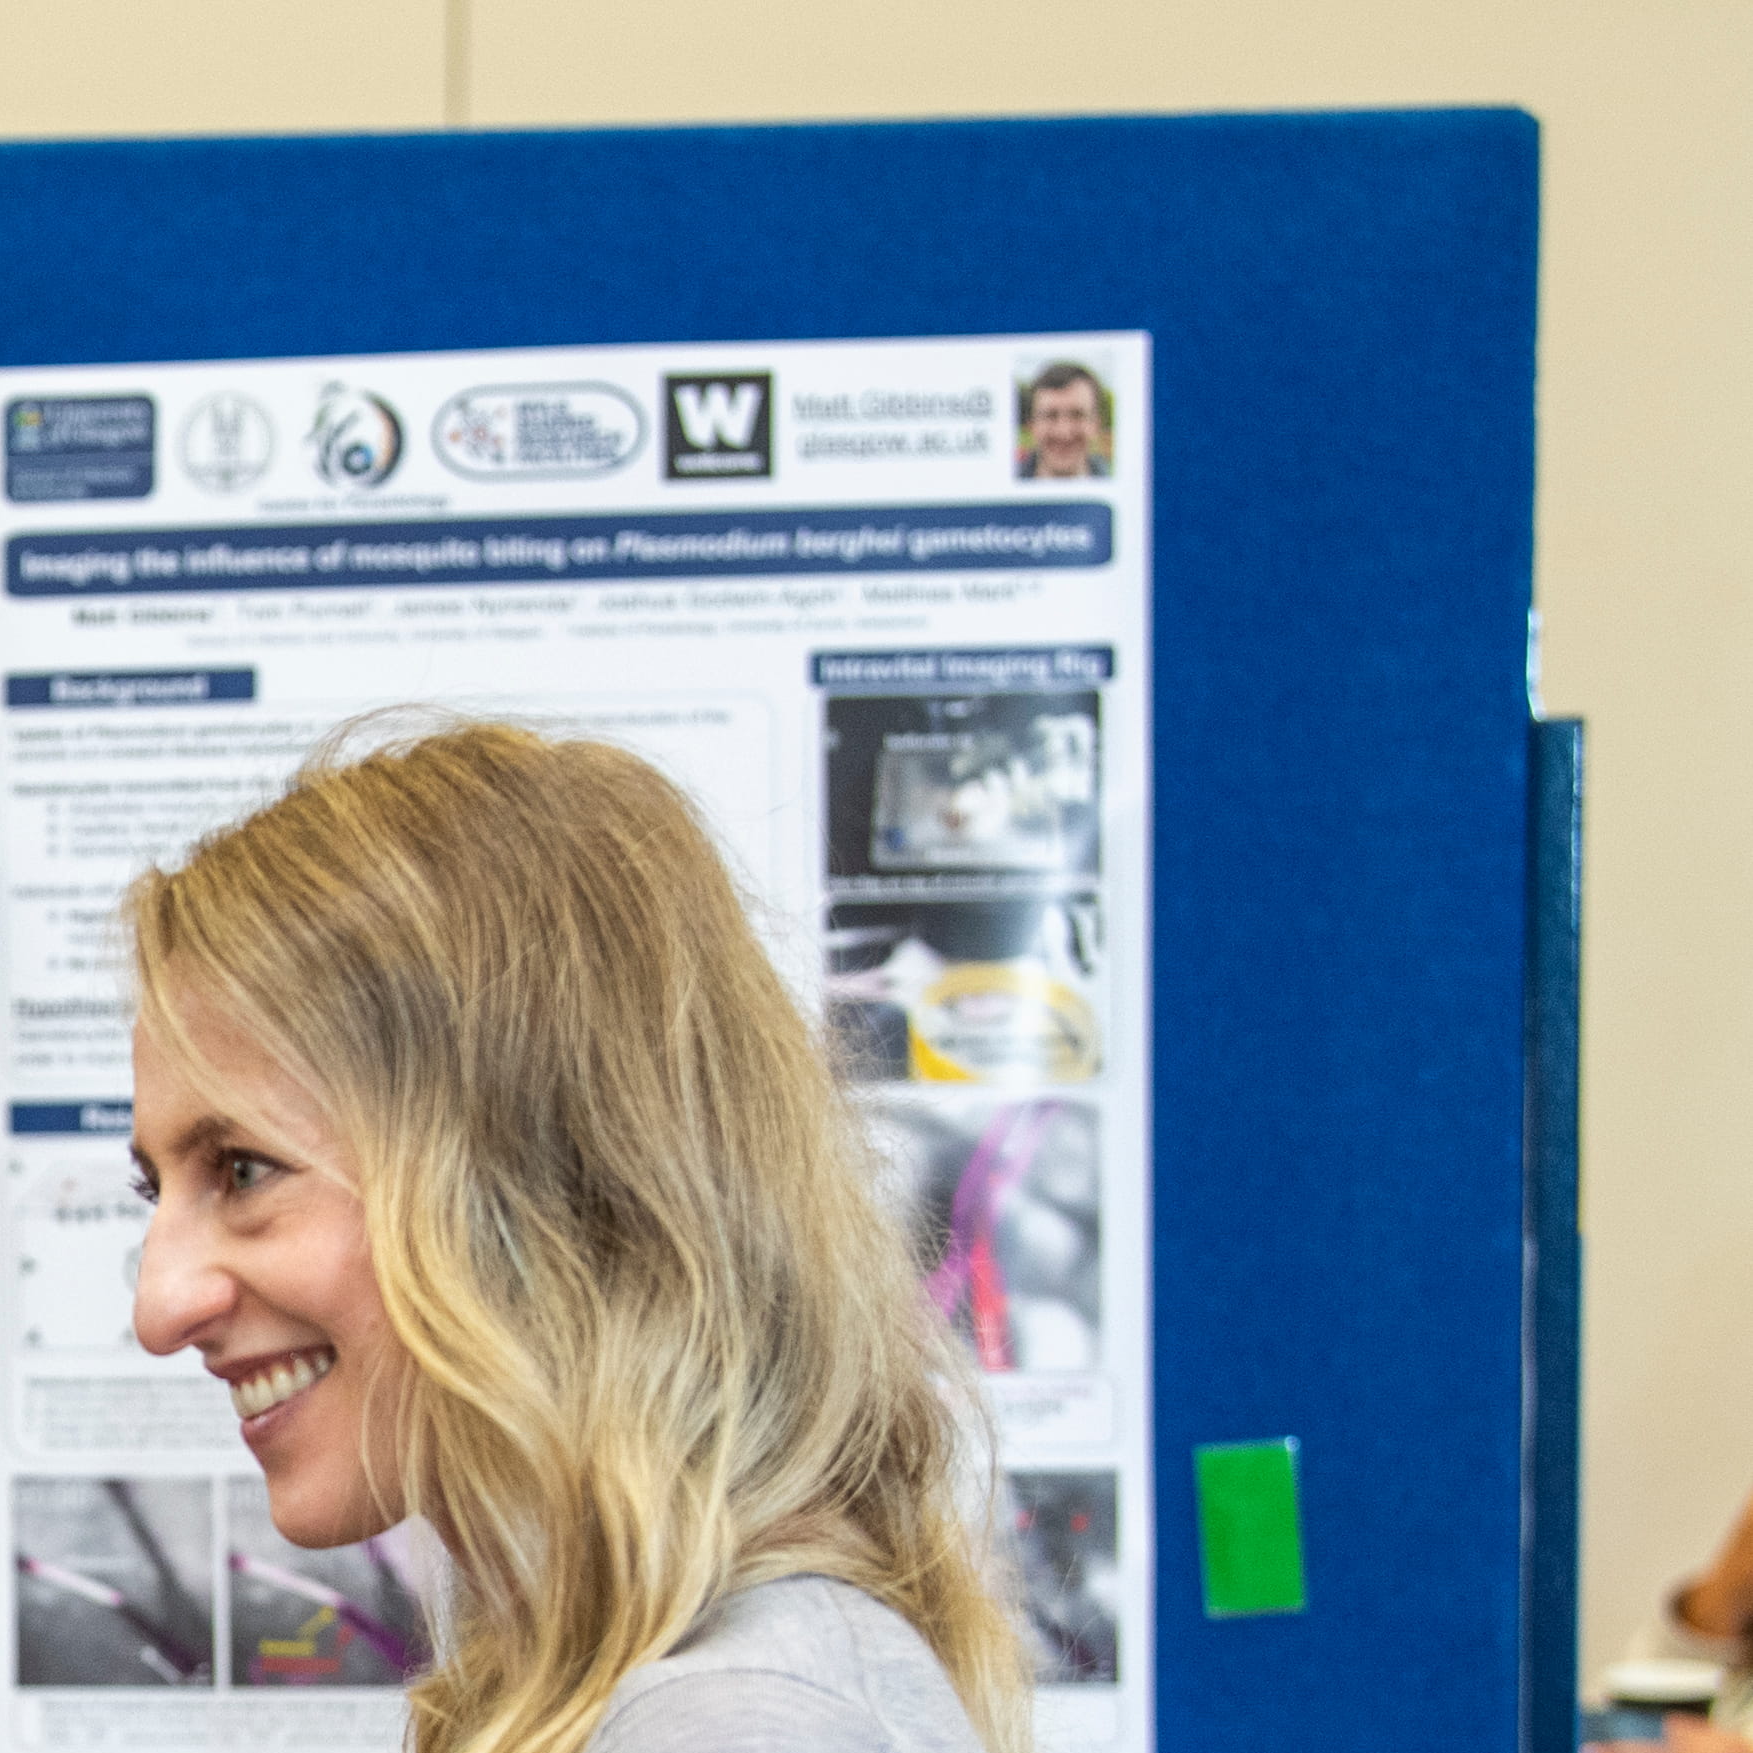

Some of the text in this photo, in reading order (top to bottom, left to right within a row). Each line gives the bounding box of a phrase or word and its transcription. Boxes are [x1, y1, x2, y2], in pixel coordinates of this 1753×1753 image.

[674, 382, 762, 450] W
[20, 521, 1095, 587] Imaging the influence of mosquito biting on Plasmodium berghei gametocytes
[51, 675, 208, 706] Background
